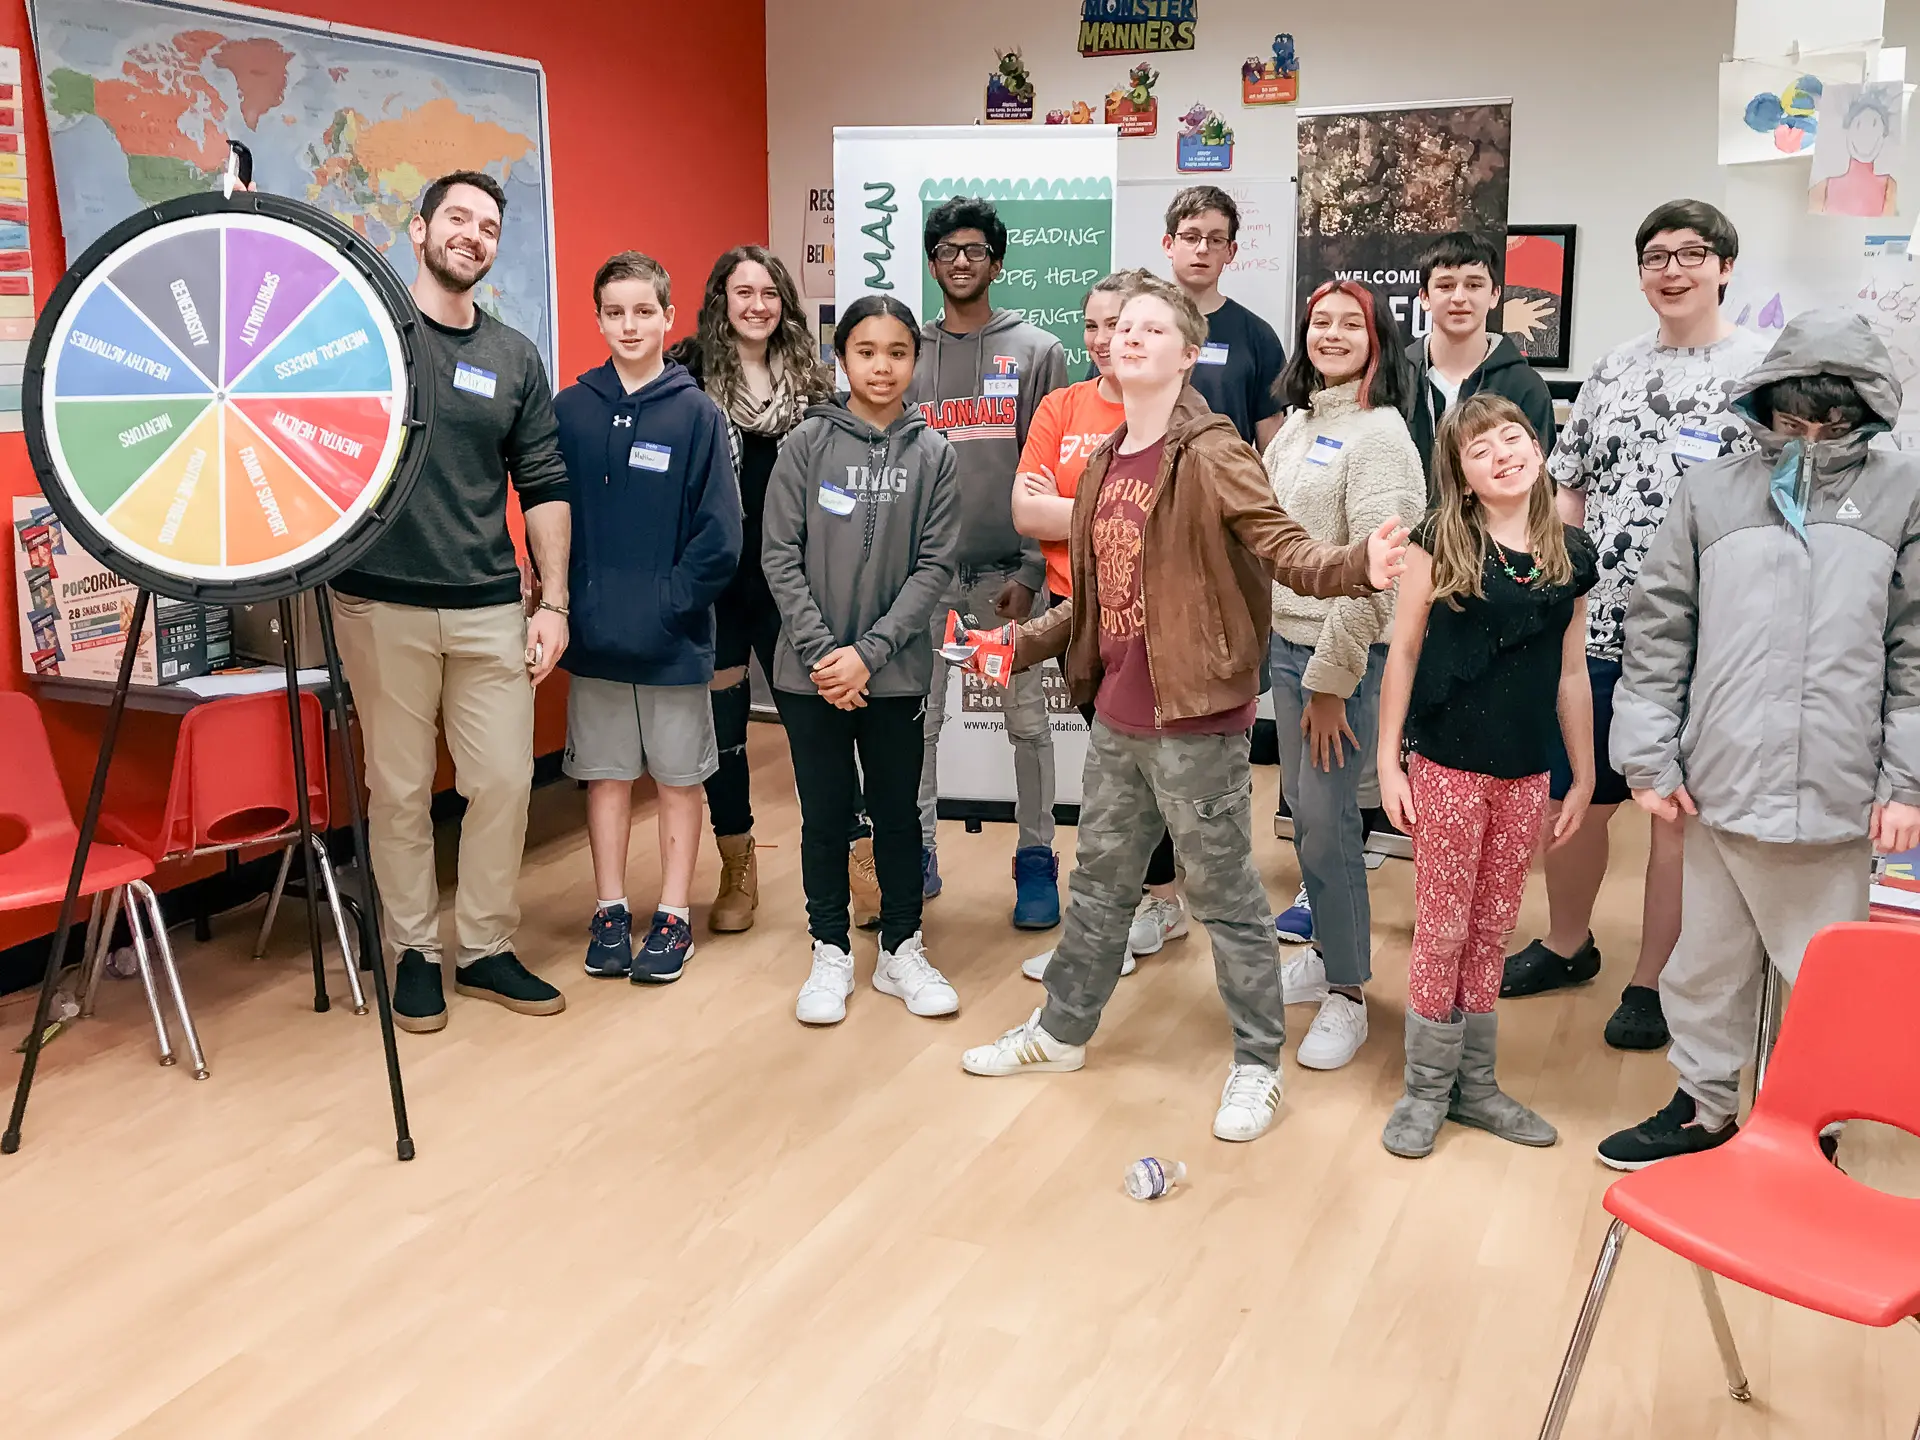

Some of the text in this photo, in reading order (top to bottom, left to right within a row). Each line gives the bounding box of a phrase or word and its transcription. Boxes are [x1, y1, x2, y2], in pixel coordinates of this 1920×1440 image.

[1080, 21, 1194, 52] MANNERS
[807, 245, 835, 263] BEIN
[991, 267, 1098, 290] OPE, HELP
[169, 278, 210, 347] GENEROSITY
[239, 271, 281, 347] SPIRITUALITY
[69, 329, 172, 382] HEALTHY ACTIVITIES
[273, 328, 369, 380] MEDICAL ACCESS
[117, 412, 173, 448] MENTORS
[272, 410, 363, 459] MENTAL HEALTH
[238, 446, 289, 537] FAMILY SUPPORT
[846, 466, 908, 493] IMG
[69, 608, 81, 620] 28
